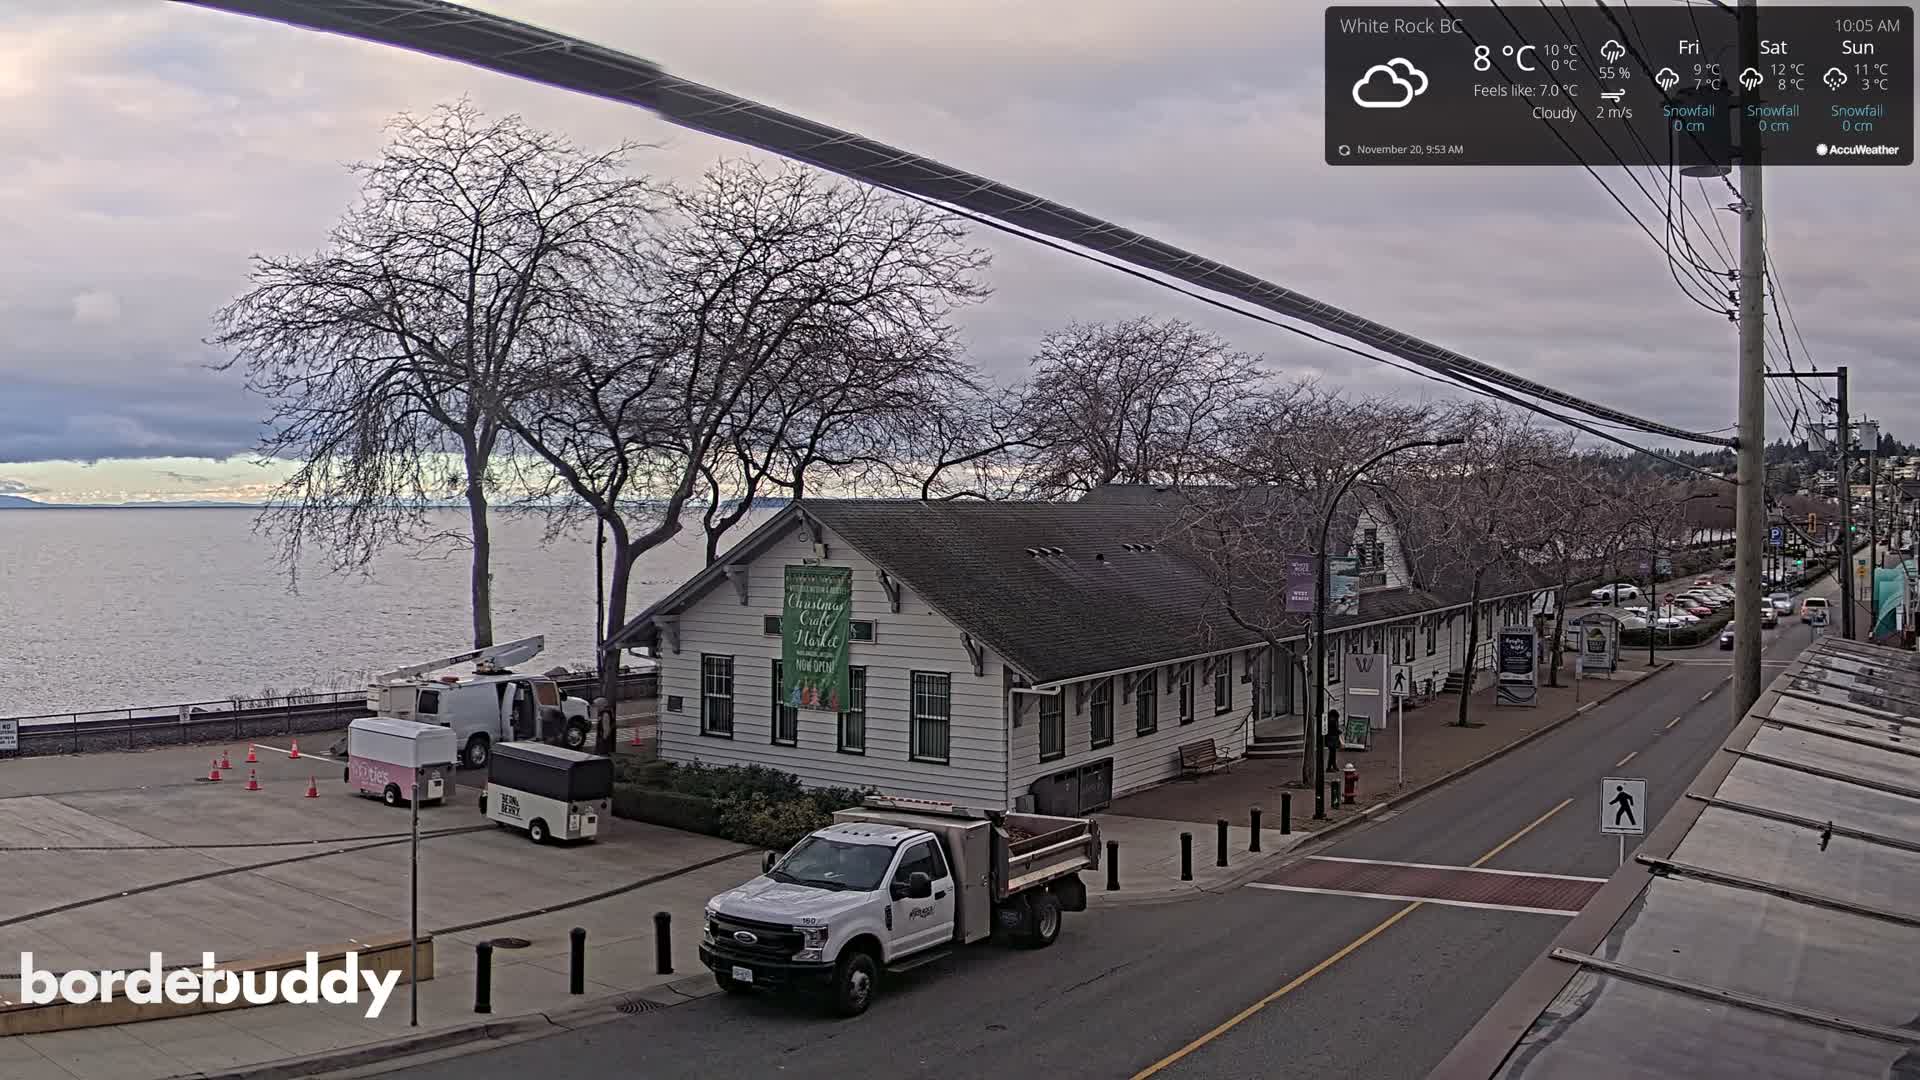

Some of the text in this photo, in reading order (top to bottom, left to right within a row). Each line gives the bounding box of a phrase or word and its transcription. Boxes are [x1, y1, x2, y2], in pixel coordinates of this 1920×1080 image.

[788, 588, 844, 611] Christmas
[800, 610, 831, 635] Craft
[793, 629, 840, 648] Market
[796, 659, 812, 672] NOW
